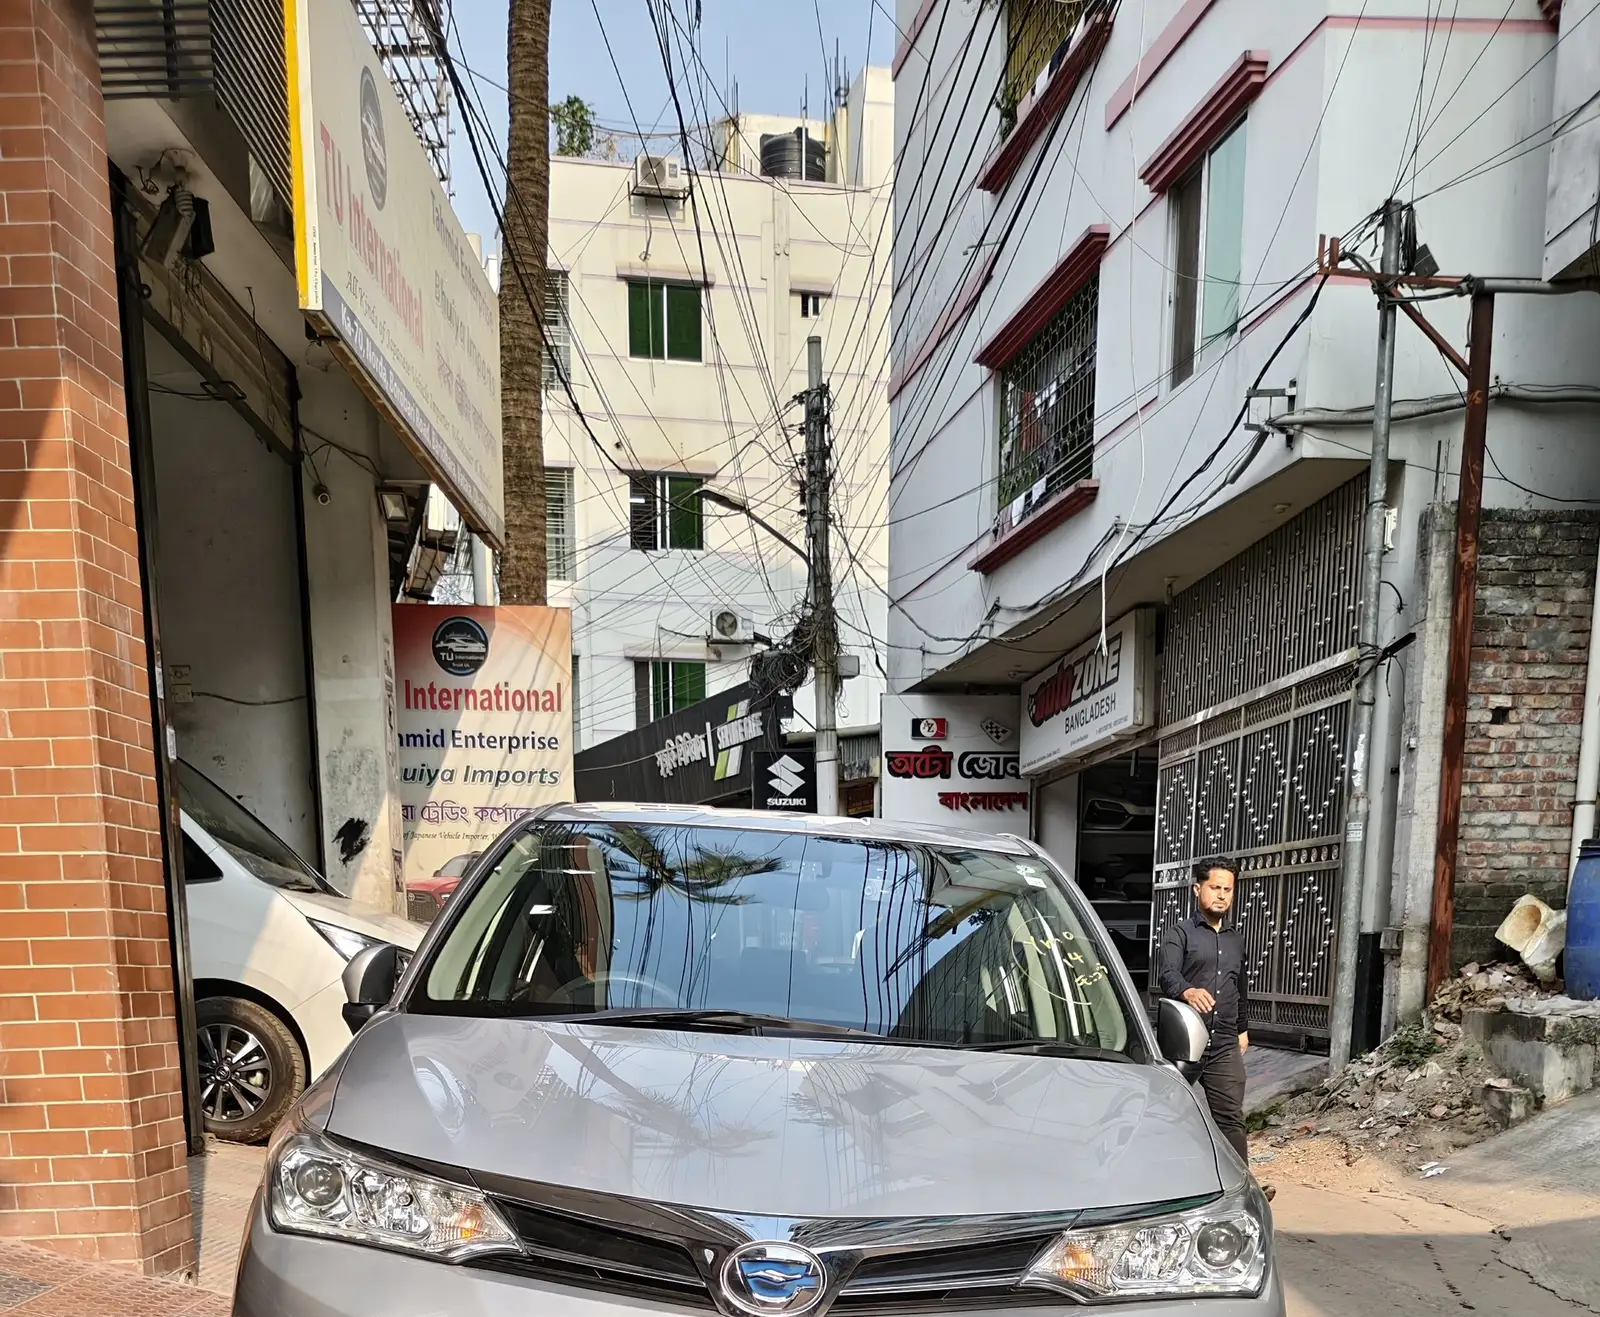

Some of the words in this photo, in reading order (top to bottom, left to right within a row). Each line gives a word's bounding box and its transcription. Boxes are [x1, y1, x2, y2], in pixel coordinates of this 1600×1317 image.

[320, 119, 344, 227] TU
[347, 164, 425, 353] International
[440, 652, 454, 661] TU
[404, 679, 562, 713] International
[1065, 692, 1117, 735] BANGLADESH
[451, 730, 559, 754] Enterprise
[885, 744, 954, 780] অটো
[403, 763, 455, 787] uiya
[463, 765, 560, 788] Imports
[766, 798, 807, 807] SUZUKI
[938, 791, 1029, 814] বাংলাদেশ
